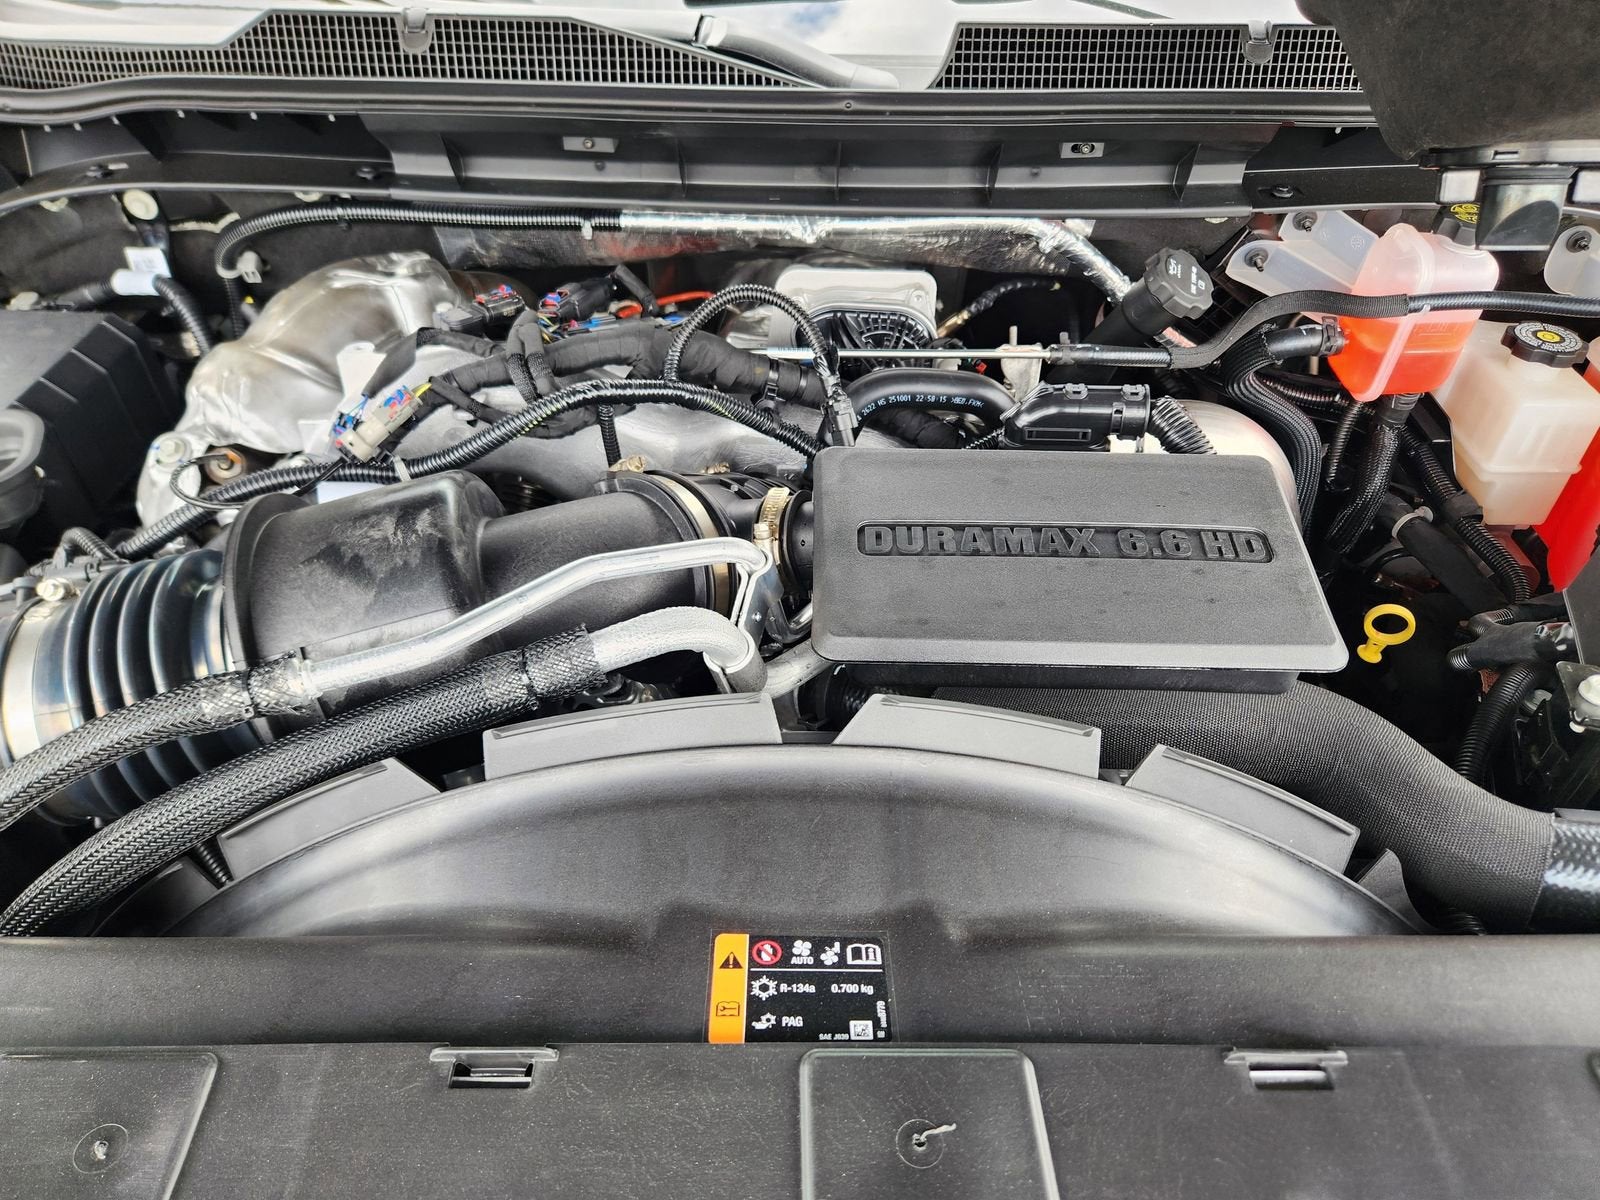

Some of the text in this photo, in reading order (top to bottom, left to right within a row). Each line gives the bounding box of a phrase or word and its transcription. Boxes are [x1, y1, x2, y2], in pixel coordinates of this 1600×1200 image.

[863, 525, 1268, 561] DURAMAX 6.6 HD
[791, 956, 813, 965] AUTO
[780, 983, 874, 995] R-134a 0.700 kg
[781, 1016, 804, 1027] PAG
